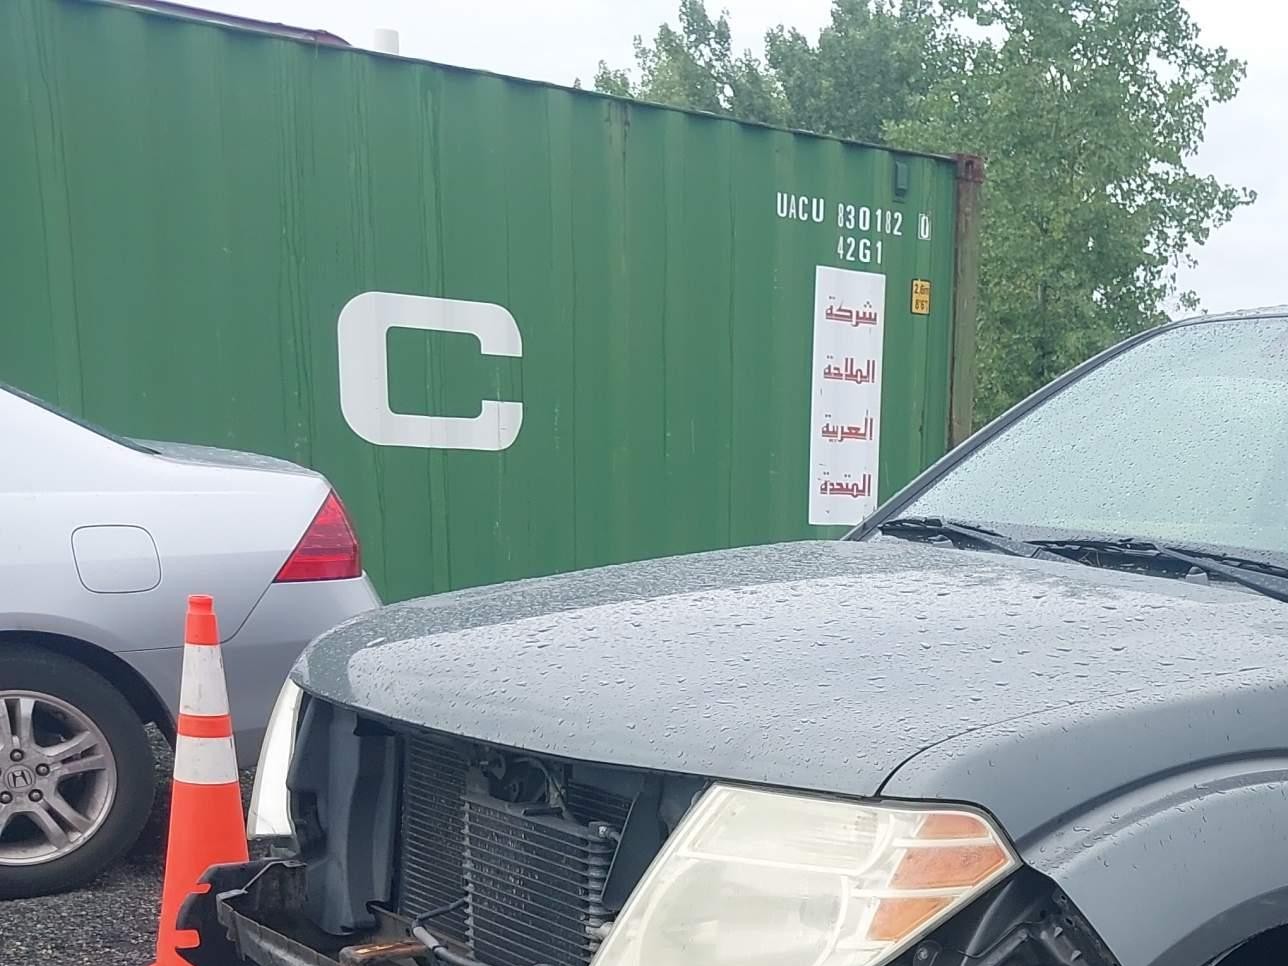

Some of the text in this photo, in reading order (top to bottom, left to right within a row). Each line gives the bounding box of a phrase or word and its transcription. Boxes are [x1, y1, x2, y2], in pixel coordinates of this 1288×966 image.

[776, 191, 825, 223] UACU
[837, 202, 903, 237] 830182
[837, 237, 883, 265] 42G1
[825, 296, 877, 327] شركة
[337, 291, 524, 452] C
[823, 355, 875, 385] الملاحة
[821, 413, 874, 443] العربية
[819, 472, 871, 498] المتحدة
